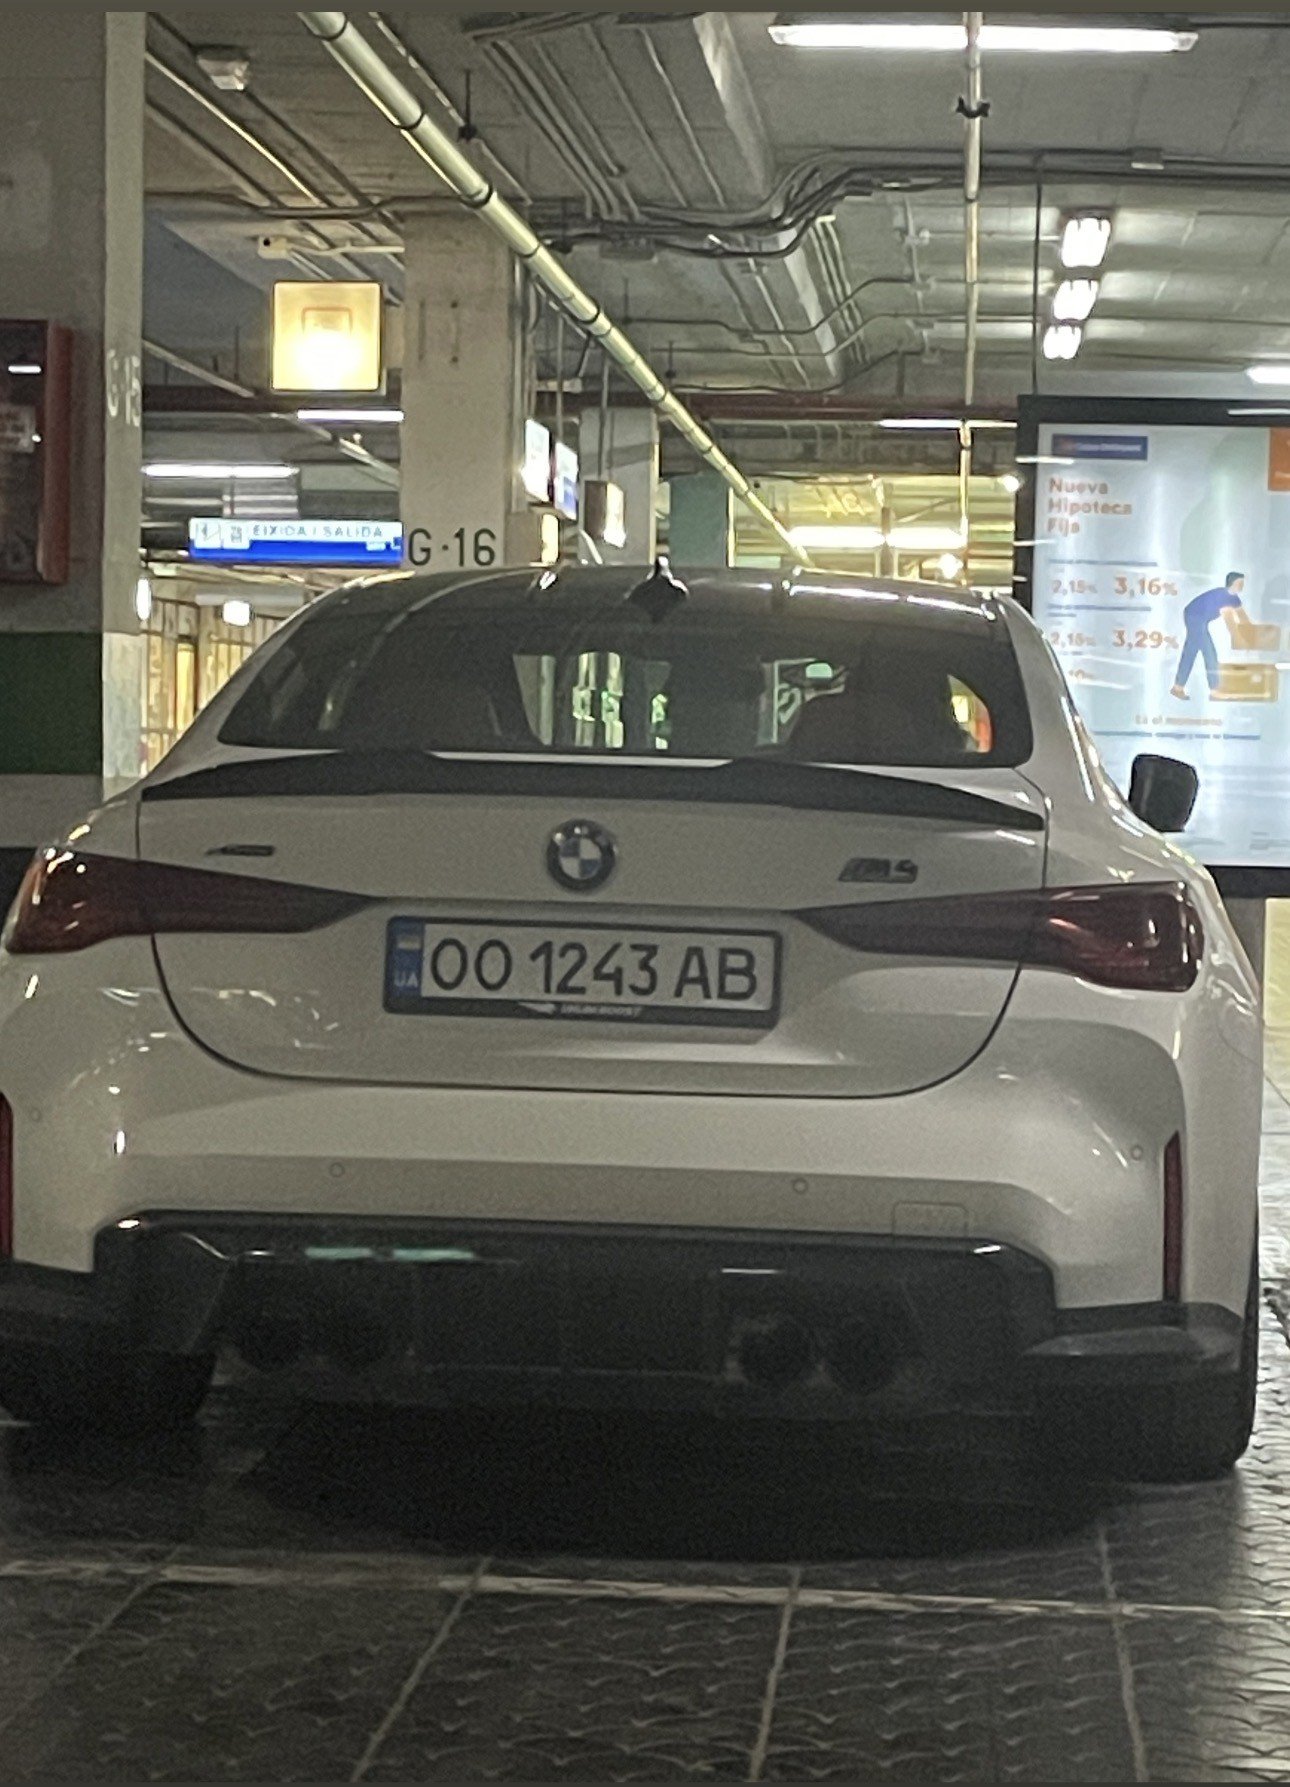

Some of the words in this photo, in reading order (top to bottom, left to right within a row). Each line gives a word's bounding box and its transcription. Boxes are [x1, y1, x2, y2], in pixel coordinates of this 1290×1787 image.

[1050, 477, 1108, 495] Nueva
[1048, 497, 1132, 516] Hipoteca
[323, 526, 383, 538] SALIDA
[1114, 576, 1178, 597] 3,16%
[395, 970, 418, 988] UA
[529, 940, 660, 997] 1243
[673, 945, 758, 1000] AB
